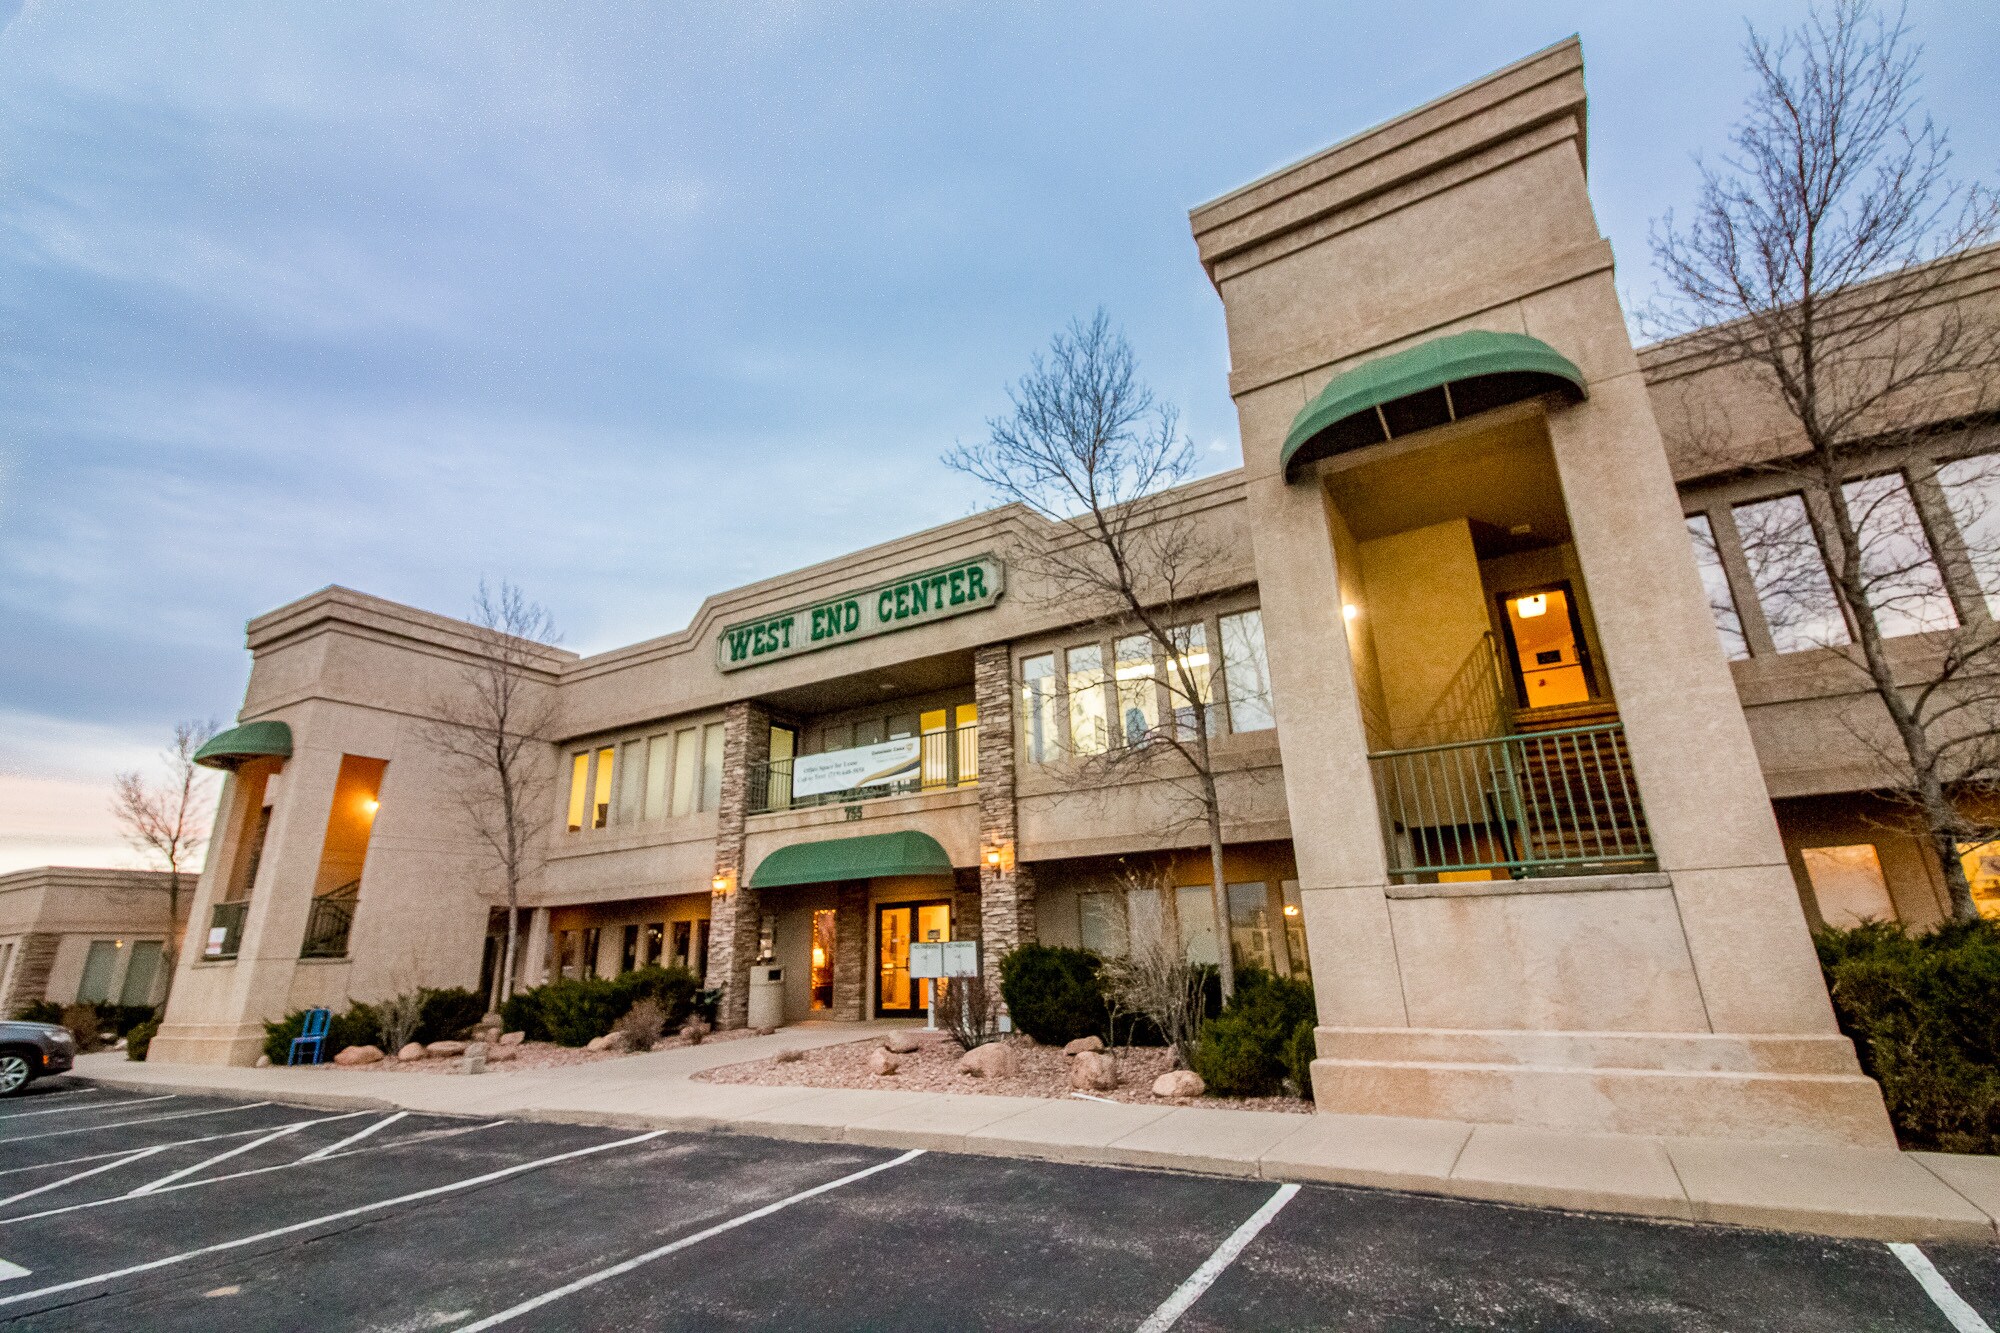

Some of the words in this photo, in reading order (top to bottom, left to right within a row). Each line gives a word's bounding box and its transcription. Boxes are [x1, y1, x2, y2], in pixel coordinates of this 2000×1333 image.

[728, 617, 794, 662] WEST
[811, 600, 859, 641] END
[878, 566, 988, 622] CENTER
[845, 805, 863, 821] 755
